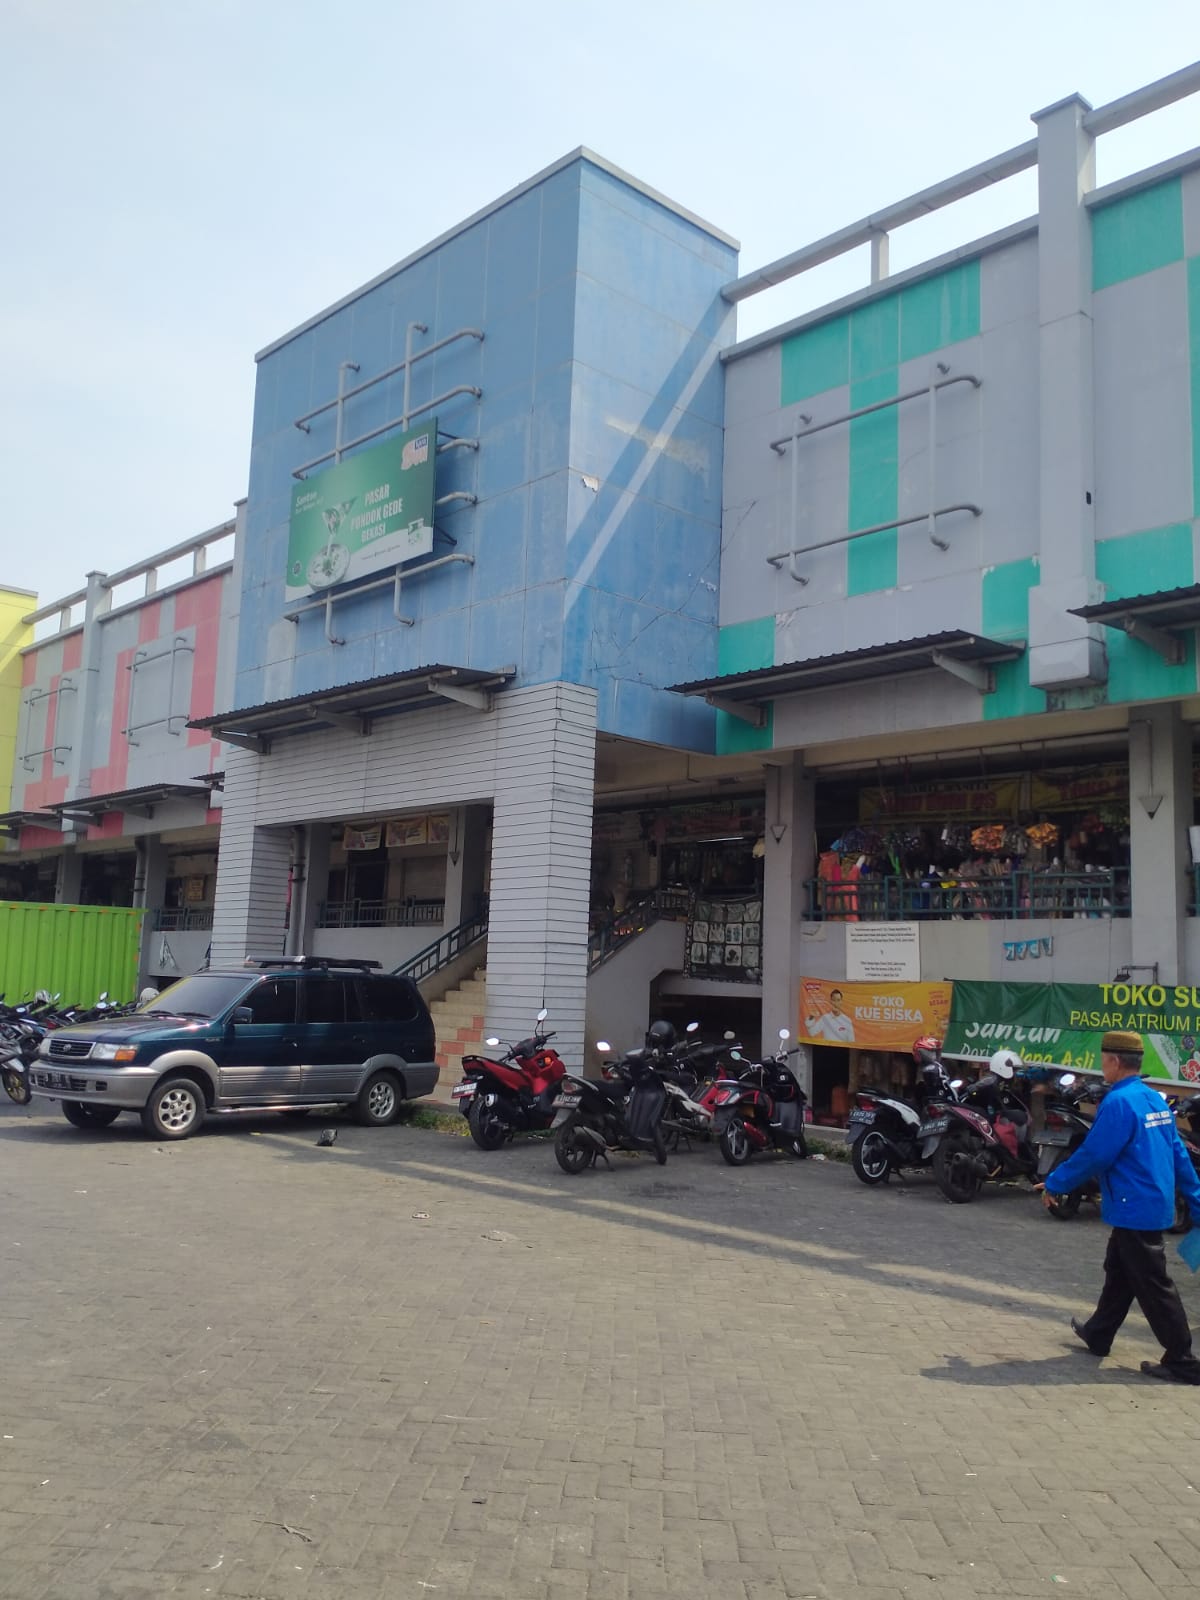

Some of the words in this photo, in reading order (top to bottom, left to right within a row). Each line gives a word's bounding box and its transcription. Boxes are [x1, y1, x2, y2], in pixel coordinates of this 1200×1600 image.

[365, 483, 390, 506] PASAR
[383, 498, 404, 519] GEDE
[872, 995, 905, 1008] TOKO
[1099, 983, 1167, 1007] TOKO
[855, 1007, 881, 1020] KUE
[883, 1008, 924, 1023] SISKA
[1070, 1010, 1123, 1028] PASAR
[1126, 1013, 1190, 1032] ATRIUM
[1061, 1050, 1096, 1069] Asli
